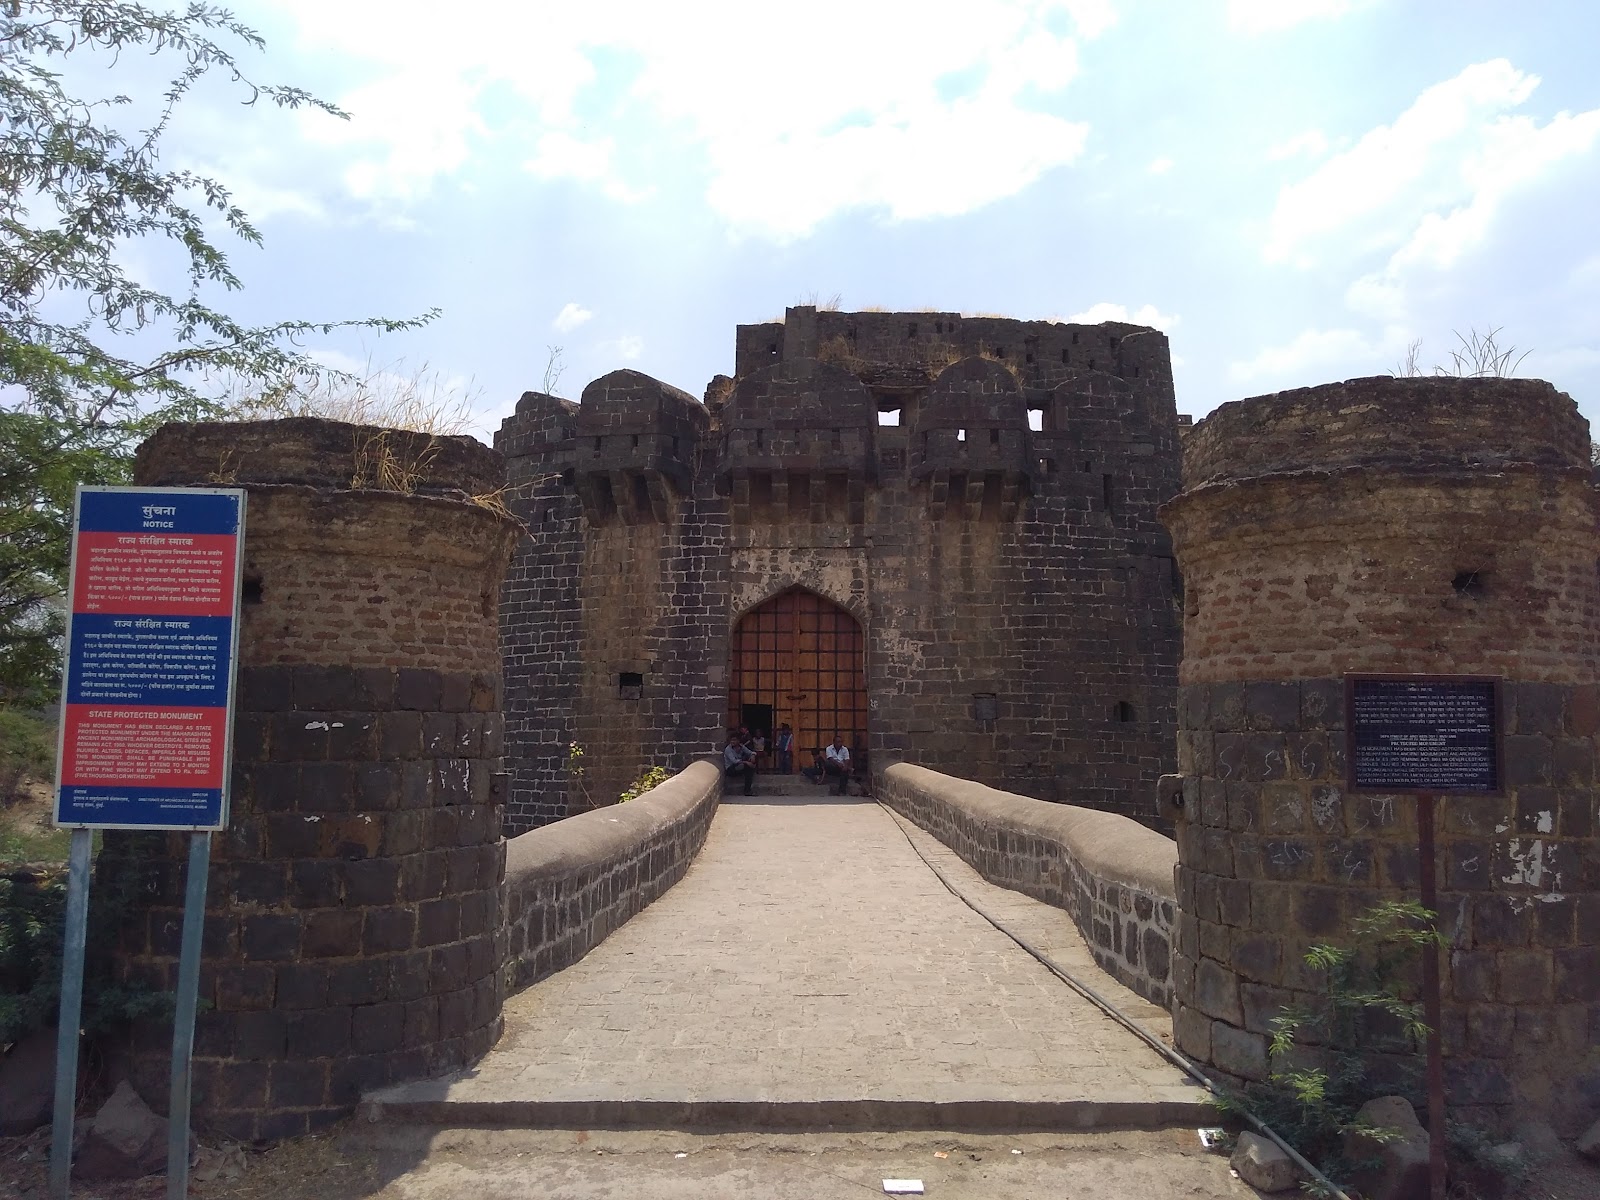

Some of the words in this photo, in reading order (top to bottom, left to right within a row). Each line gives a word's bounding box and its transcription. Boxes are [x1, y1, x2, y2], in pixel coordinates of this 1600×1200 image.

[143, 521, 174, 529] NOTICE
[135, 618, 161, 629] संरक्षित
[114, 711, 158, 719] PROTECTED
[160, 712, 203, 720] MONUMENT
